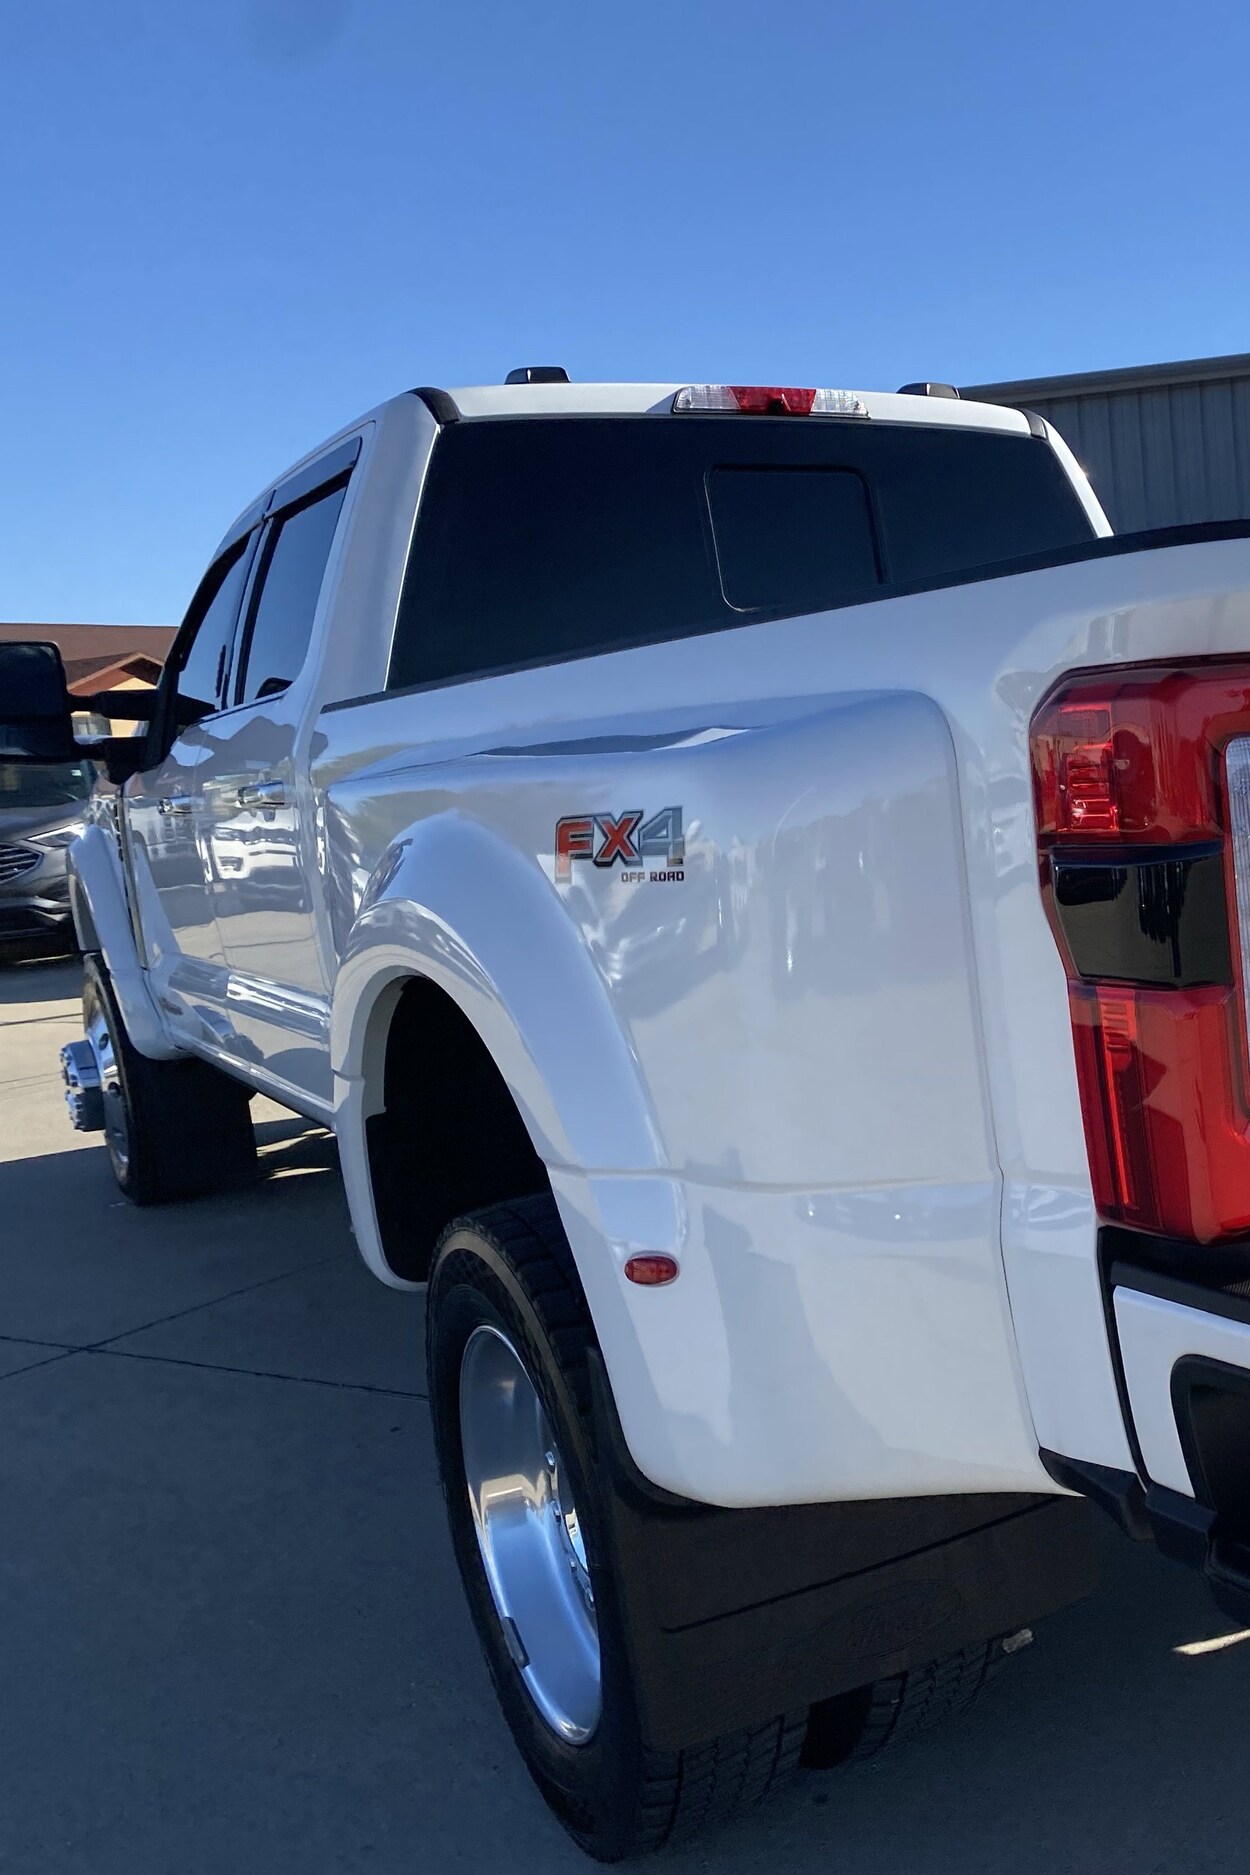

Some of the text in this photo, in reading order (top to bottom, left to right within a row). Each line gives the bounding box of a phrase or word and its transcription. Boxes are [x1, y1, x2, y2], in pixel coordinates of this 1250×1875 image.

[555, 805, 685, 884] FX4
[621, 871, 684, 883] OFF ROAD
